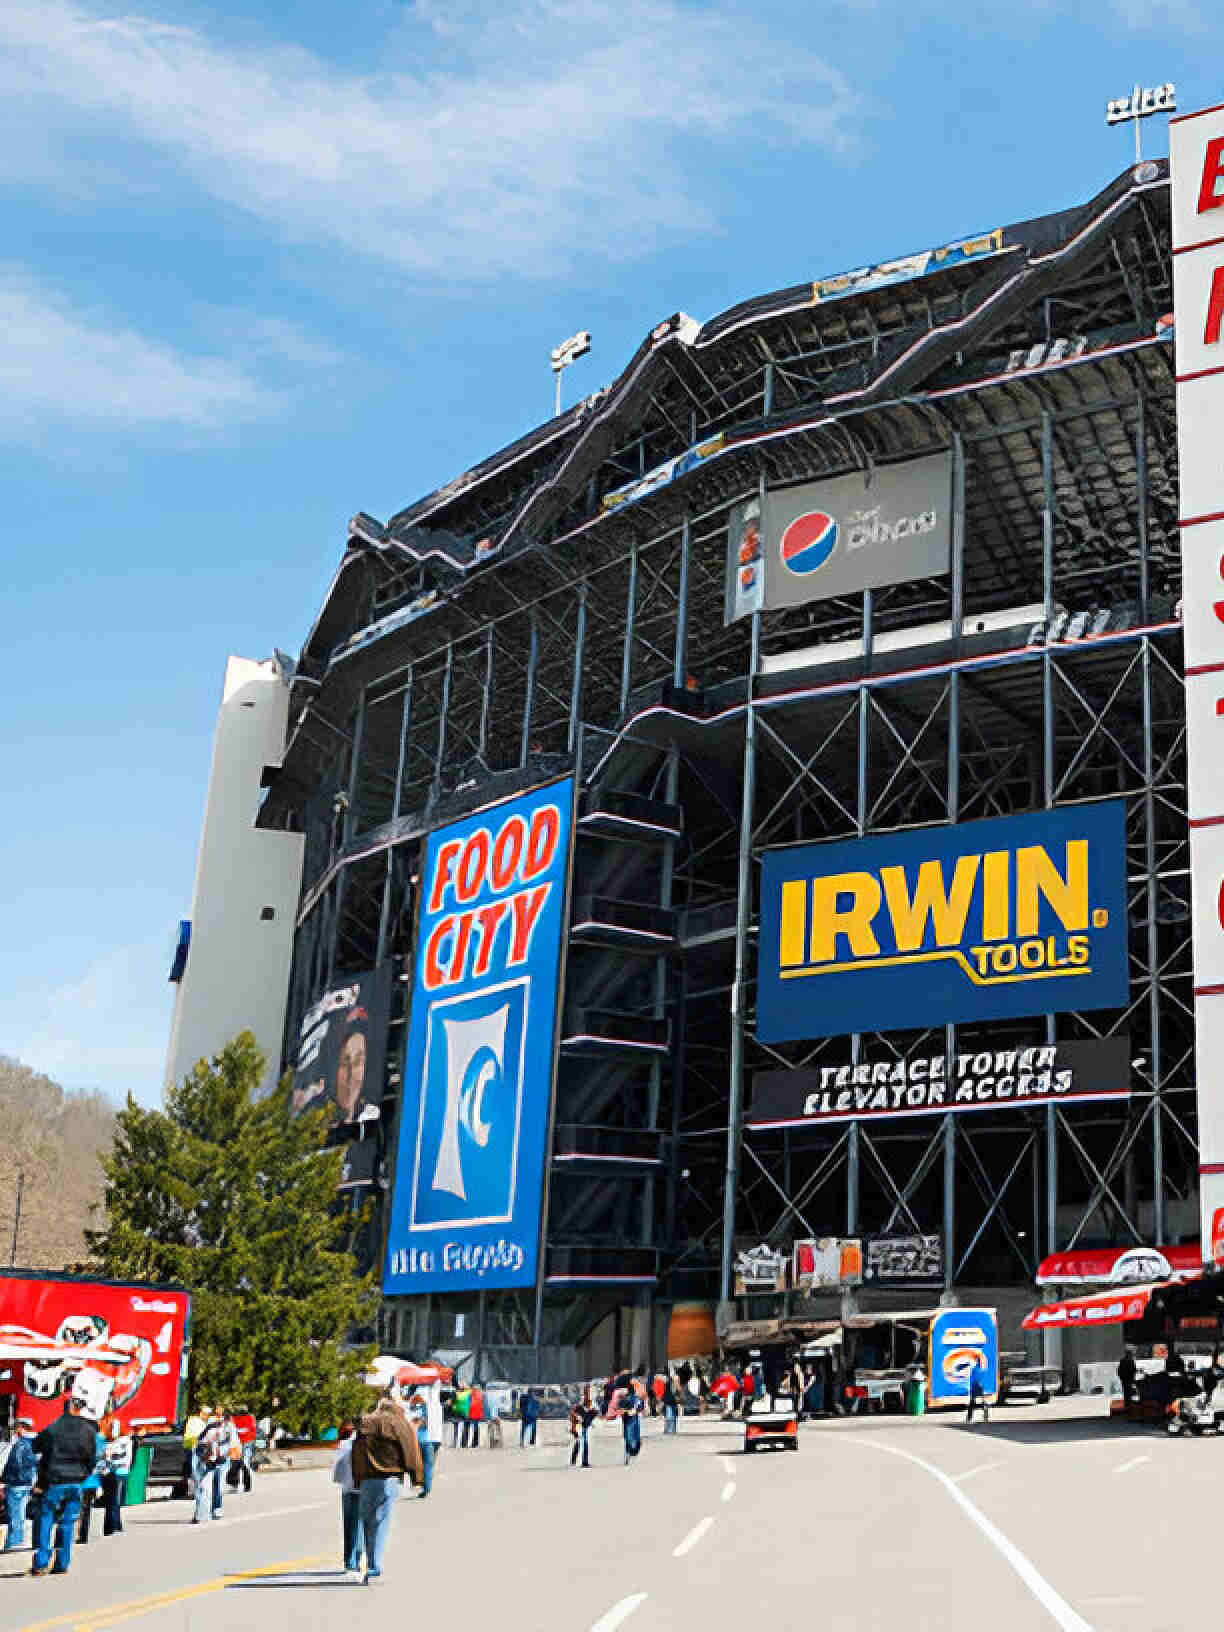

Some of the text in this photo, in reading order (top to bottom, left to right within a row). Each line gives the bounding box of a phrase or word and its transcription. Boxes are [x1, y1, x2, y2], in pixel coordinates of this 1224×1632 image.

[426, 804, 560, 914] FOOD
[423, 881, 553, 990] CITY
[779, 839, 1089, 967] IRWIN
[970, 936, 1089, 976] TOOLS
[802, 1068, 1074, 1115] ELEVATOR ACCESS
[819, 1046, 1057, 1089] TERRACE TOWER
